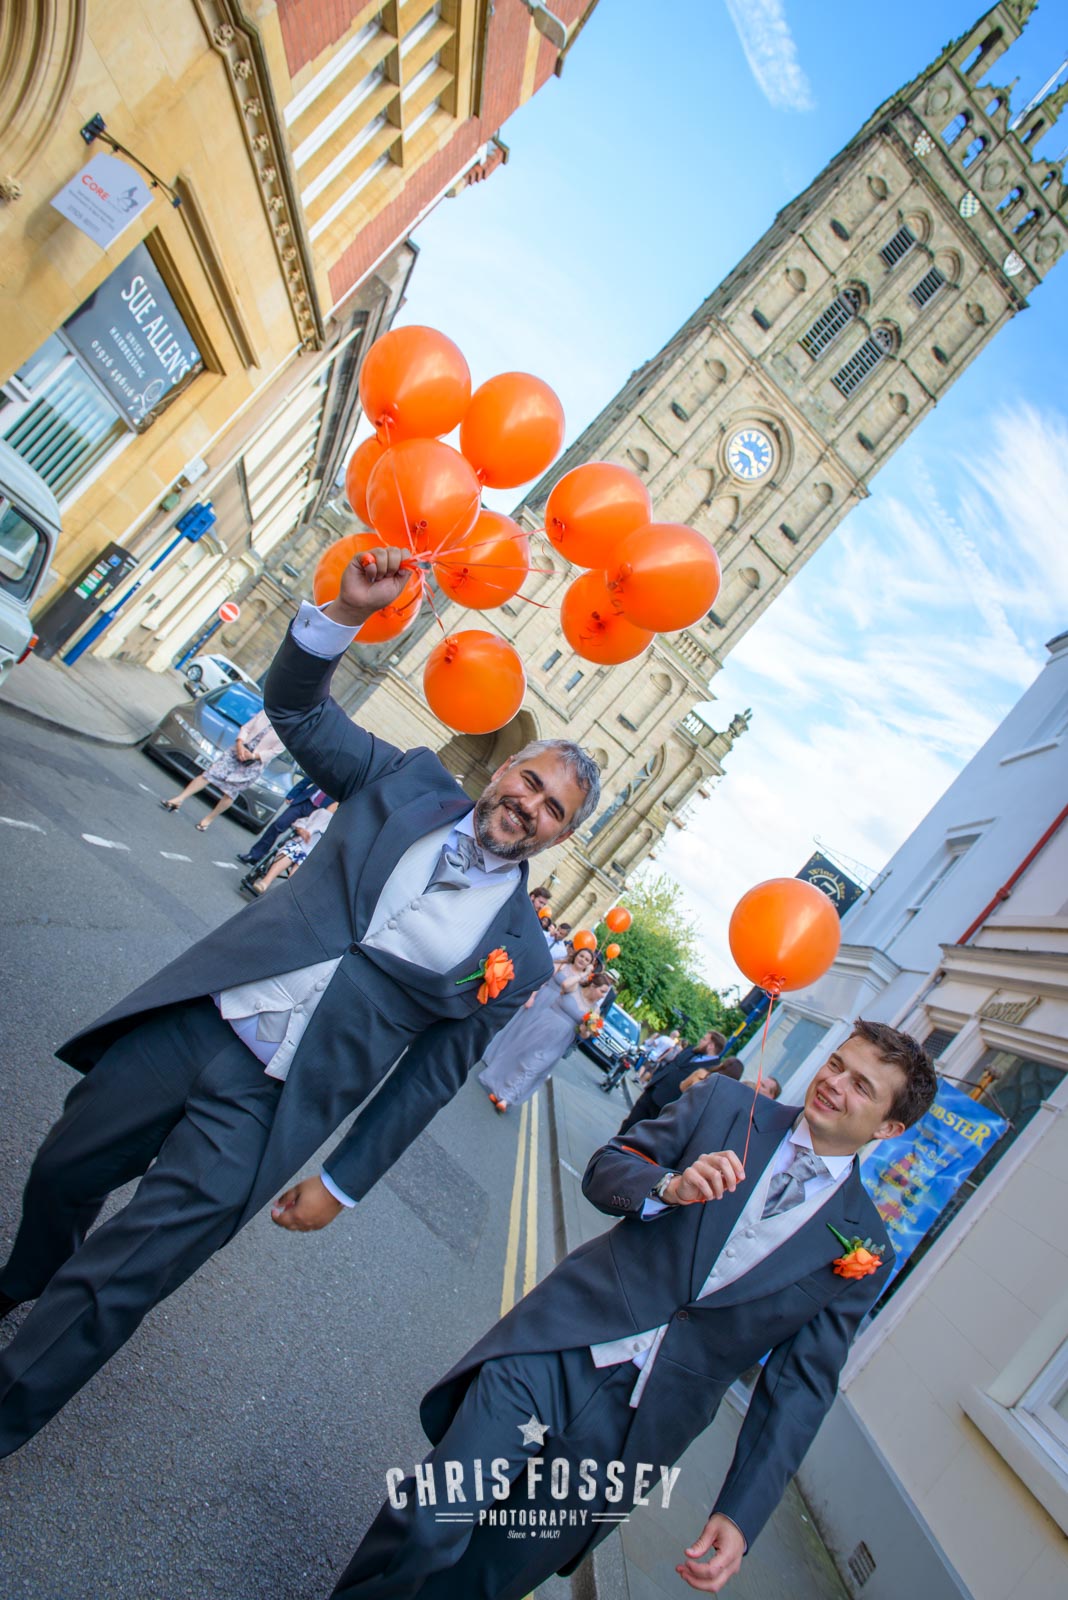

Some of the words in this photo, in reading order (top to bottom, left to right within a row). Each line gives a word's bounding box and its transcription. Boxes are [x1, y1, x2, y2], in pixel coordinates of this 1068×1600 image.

[109, 326, 146, 378] HAIRDRESSING
[121, 276, 157, 325] SUE
[142, 315, 191, 384] ALLEN'S
[126, 331, 146, 360] UNISEX
[91, 340, 112, 368] 01926
[928, 1103, 992, 1147] OBSTER
